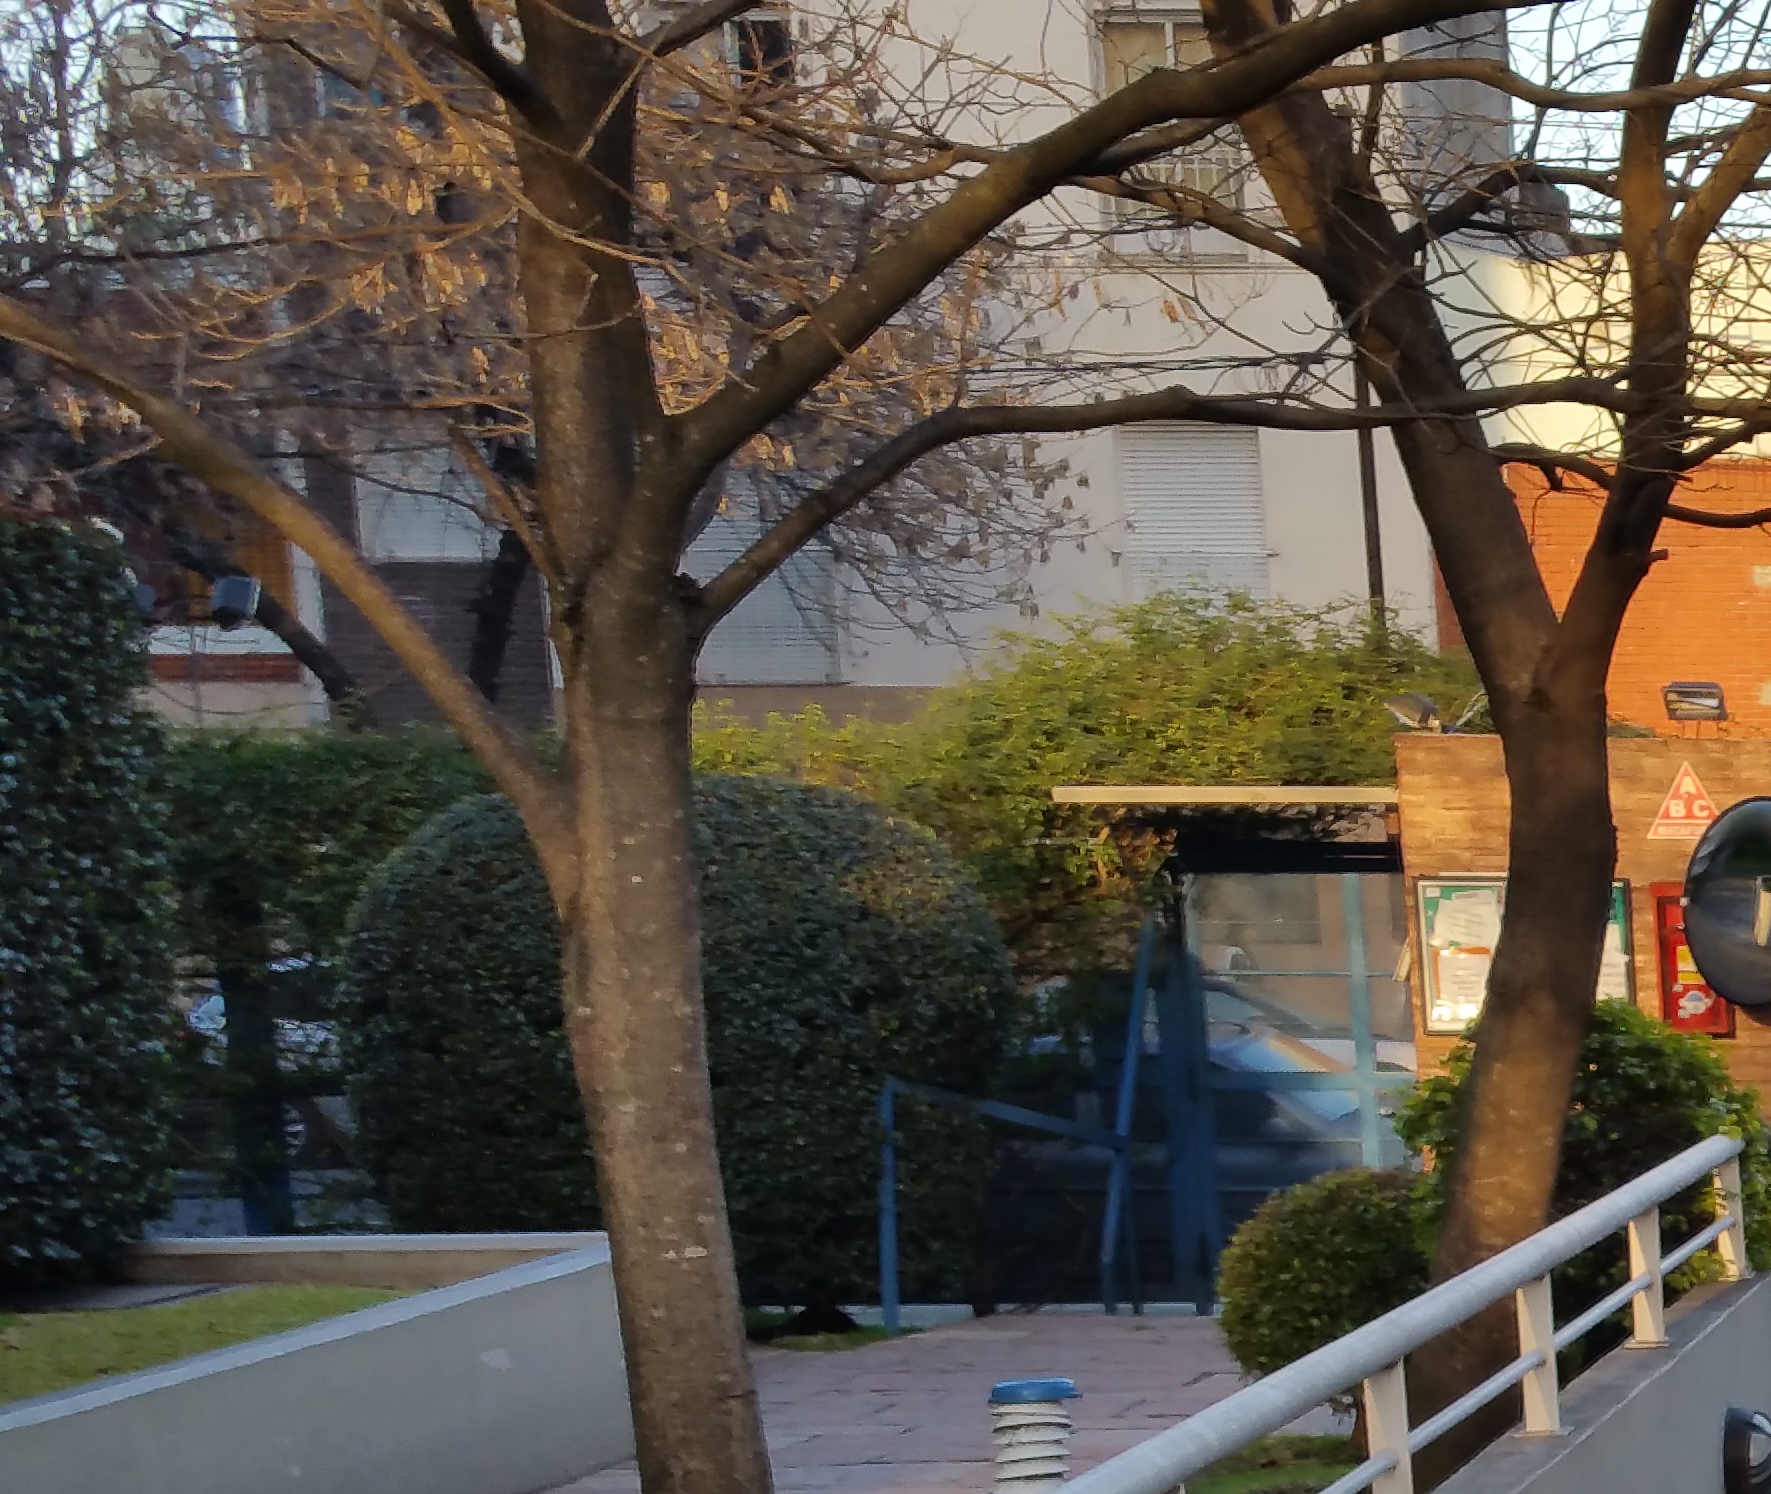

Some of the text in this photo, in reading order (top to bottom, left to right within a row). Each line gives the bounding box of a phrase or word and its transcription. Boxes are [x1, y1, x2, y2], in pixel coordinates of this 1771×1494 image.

[1680, 776, 1697, 794] A
[1669, 800, 1710, 818] B C
